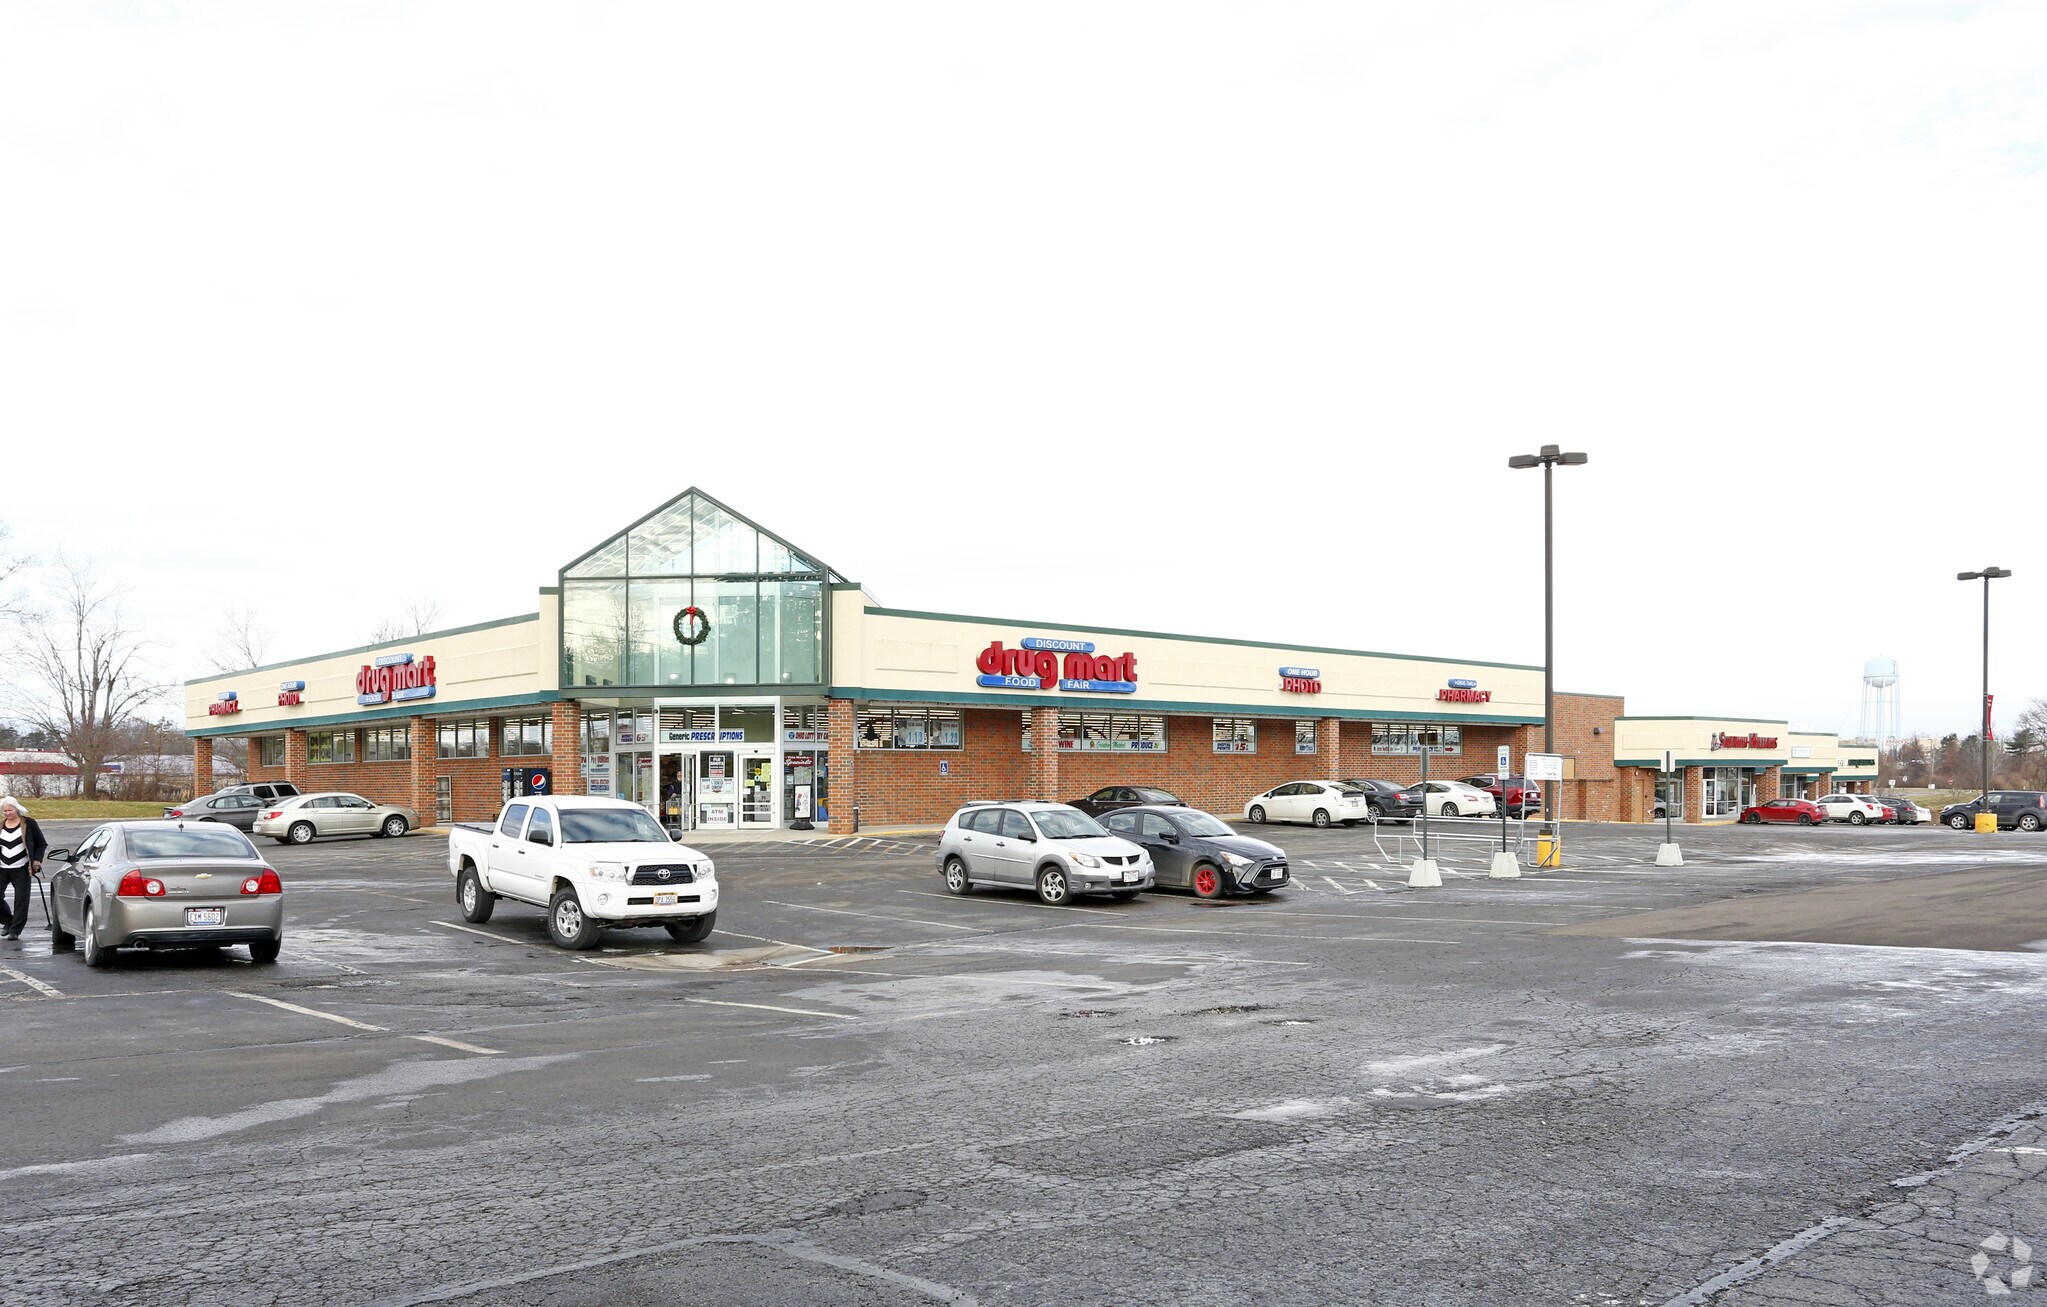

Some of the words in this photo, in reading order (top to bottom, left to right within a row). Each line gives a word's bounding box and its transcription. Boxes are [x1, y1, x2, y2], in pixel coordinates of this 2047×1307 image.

[1036, 639, 1086, 651] DISCOUNT
[378, 655, 403, 665] DISCOUNT
[976, 641, 1058, 689] drug
[1063, 651, 1138, 683] mart
[356, 665, 392, 702] drug
[392, 655, 437, 690] mart
[1287, 668, 1301, 676] ONE
[1301, 669, 1318, 677] HOUR
[1005, 677, 1037, 687] FOOD
[1067, 680, 1090, 690] FAIR
[1282, 677, 1323, 694] PHOTO
[278, 692, 300, 706] PHOTO
[1439, 689, 1492, 703] PHARMACY
[668, 732, 690, 741] Generic
[1058, 740, 1074, 748] WINE
[189, 912, 202, 922] EXM
[203, 912, 220, 922] 5602
